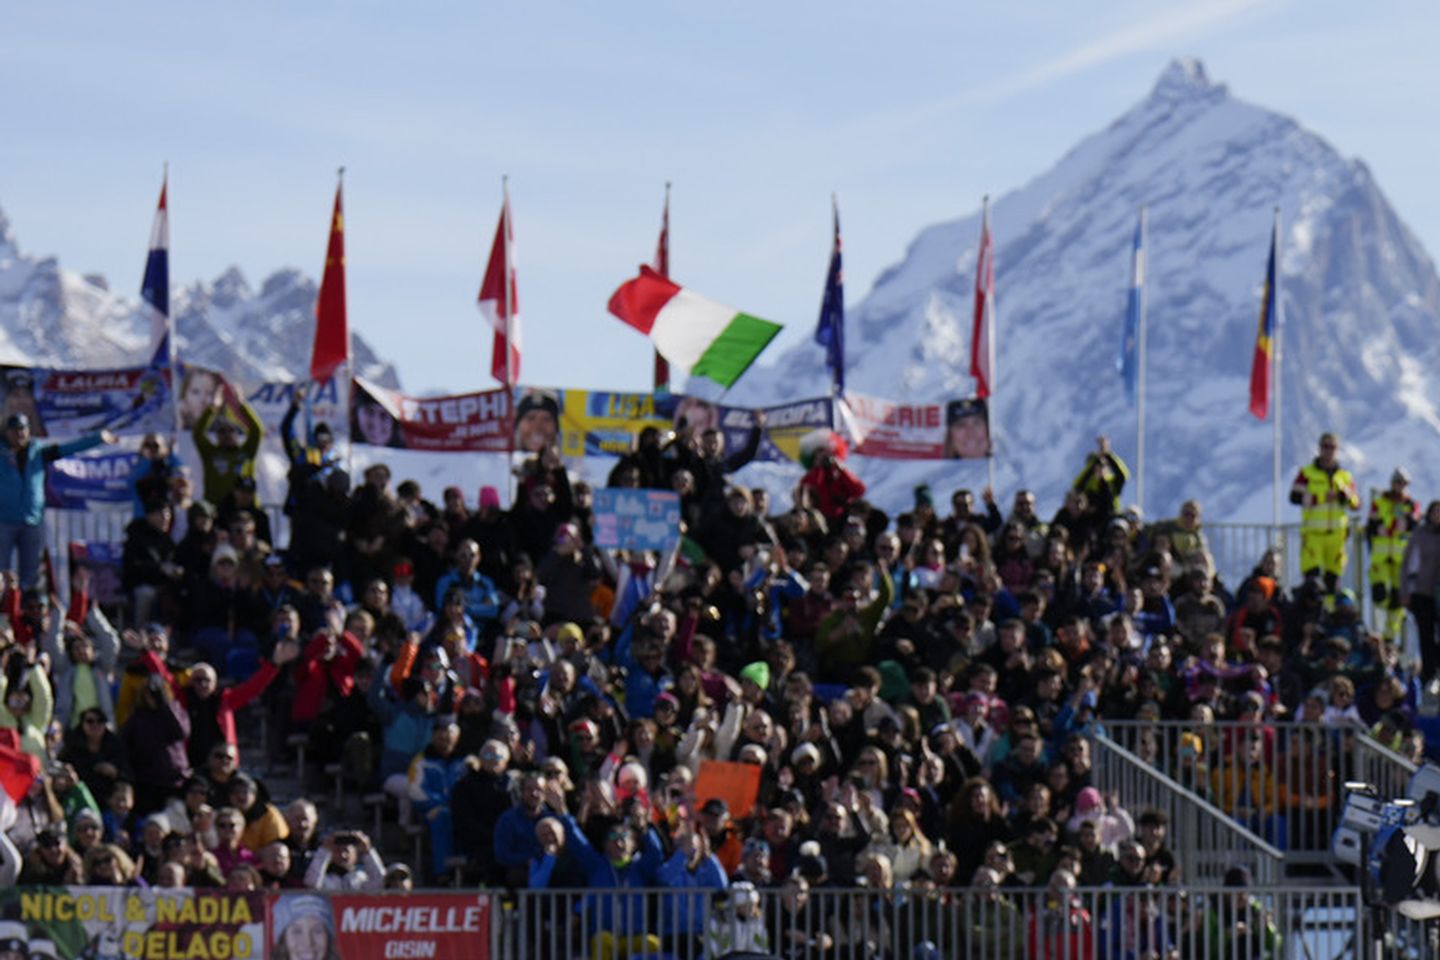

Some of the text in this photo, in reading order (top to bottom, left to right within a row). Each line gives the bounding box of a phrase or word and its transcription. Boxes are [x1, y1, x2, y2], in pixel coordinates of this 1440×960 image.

[20, 893, 253, 924] NICOL & NADIA
[340, 906, 481, 933] MICHELLE
[124, 930, 253, 960] DELAGO
[384, 939, 437, 960] GISIN
